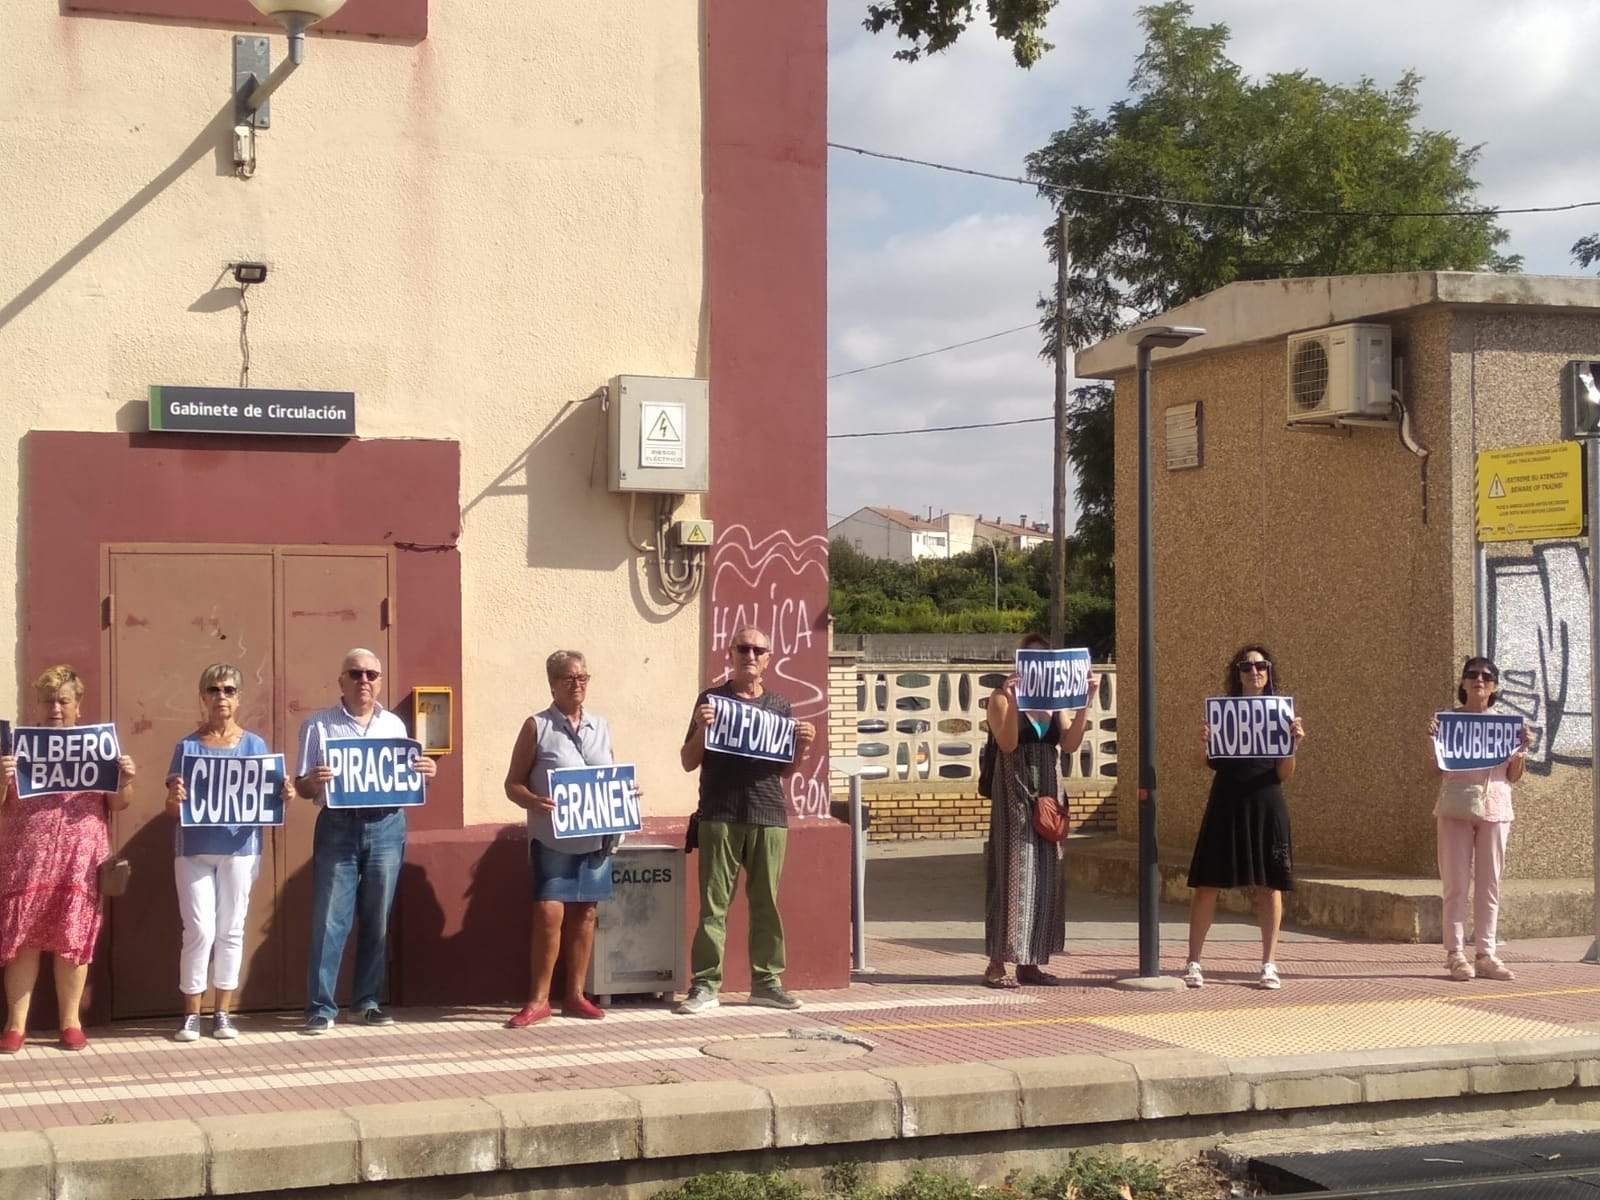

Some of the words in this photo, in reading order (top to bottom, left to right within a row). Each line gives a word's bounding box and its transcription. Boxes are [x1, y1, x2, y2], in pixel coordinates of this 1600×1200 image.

[170, 401, 238, 417] Gabinete
[244, 403, 262, 418] de
[268, 404, 347, 420] Circulación
[15, 731, 117, 762] ALBERO
[709, 697, 796, 756] VALFONDA
[1211, 700, 1292, 755] ROBRES
[1437, 720, 1521, 759] ALCUBIERRE
[31, 762, 98, 789] BAJO
[329, 746, 421, 792] PIRACES
[190, 758, 276, 823] CURBE
[554, 767, 641, 832] GRAÑÉN
[611, 869, 672, 884] CALCES
